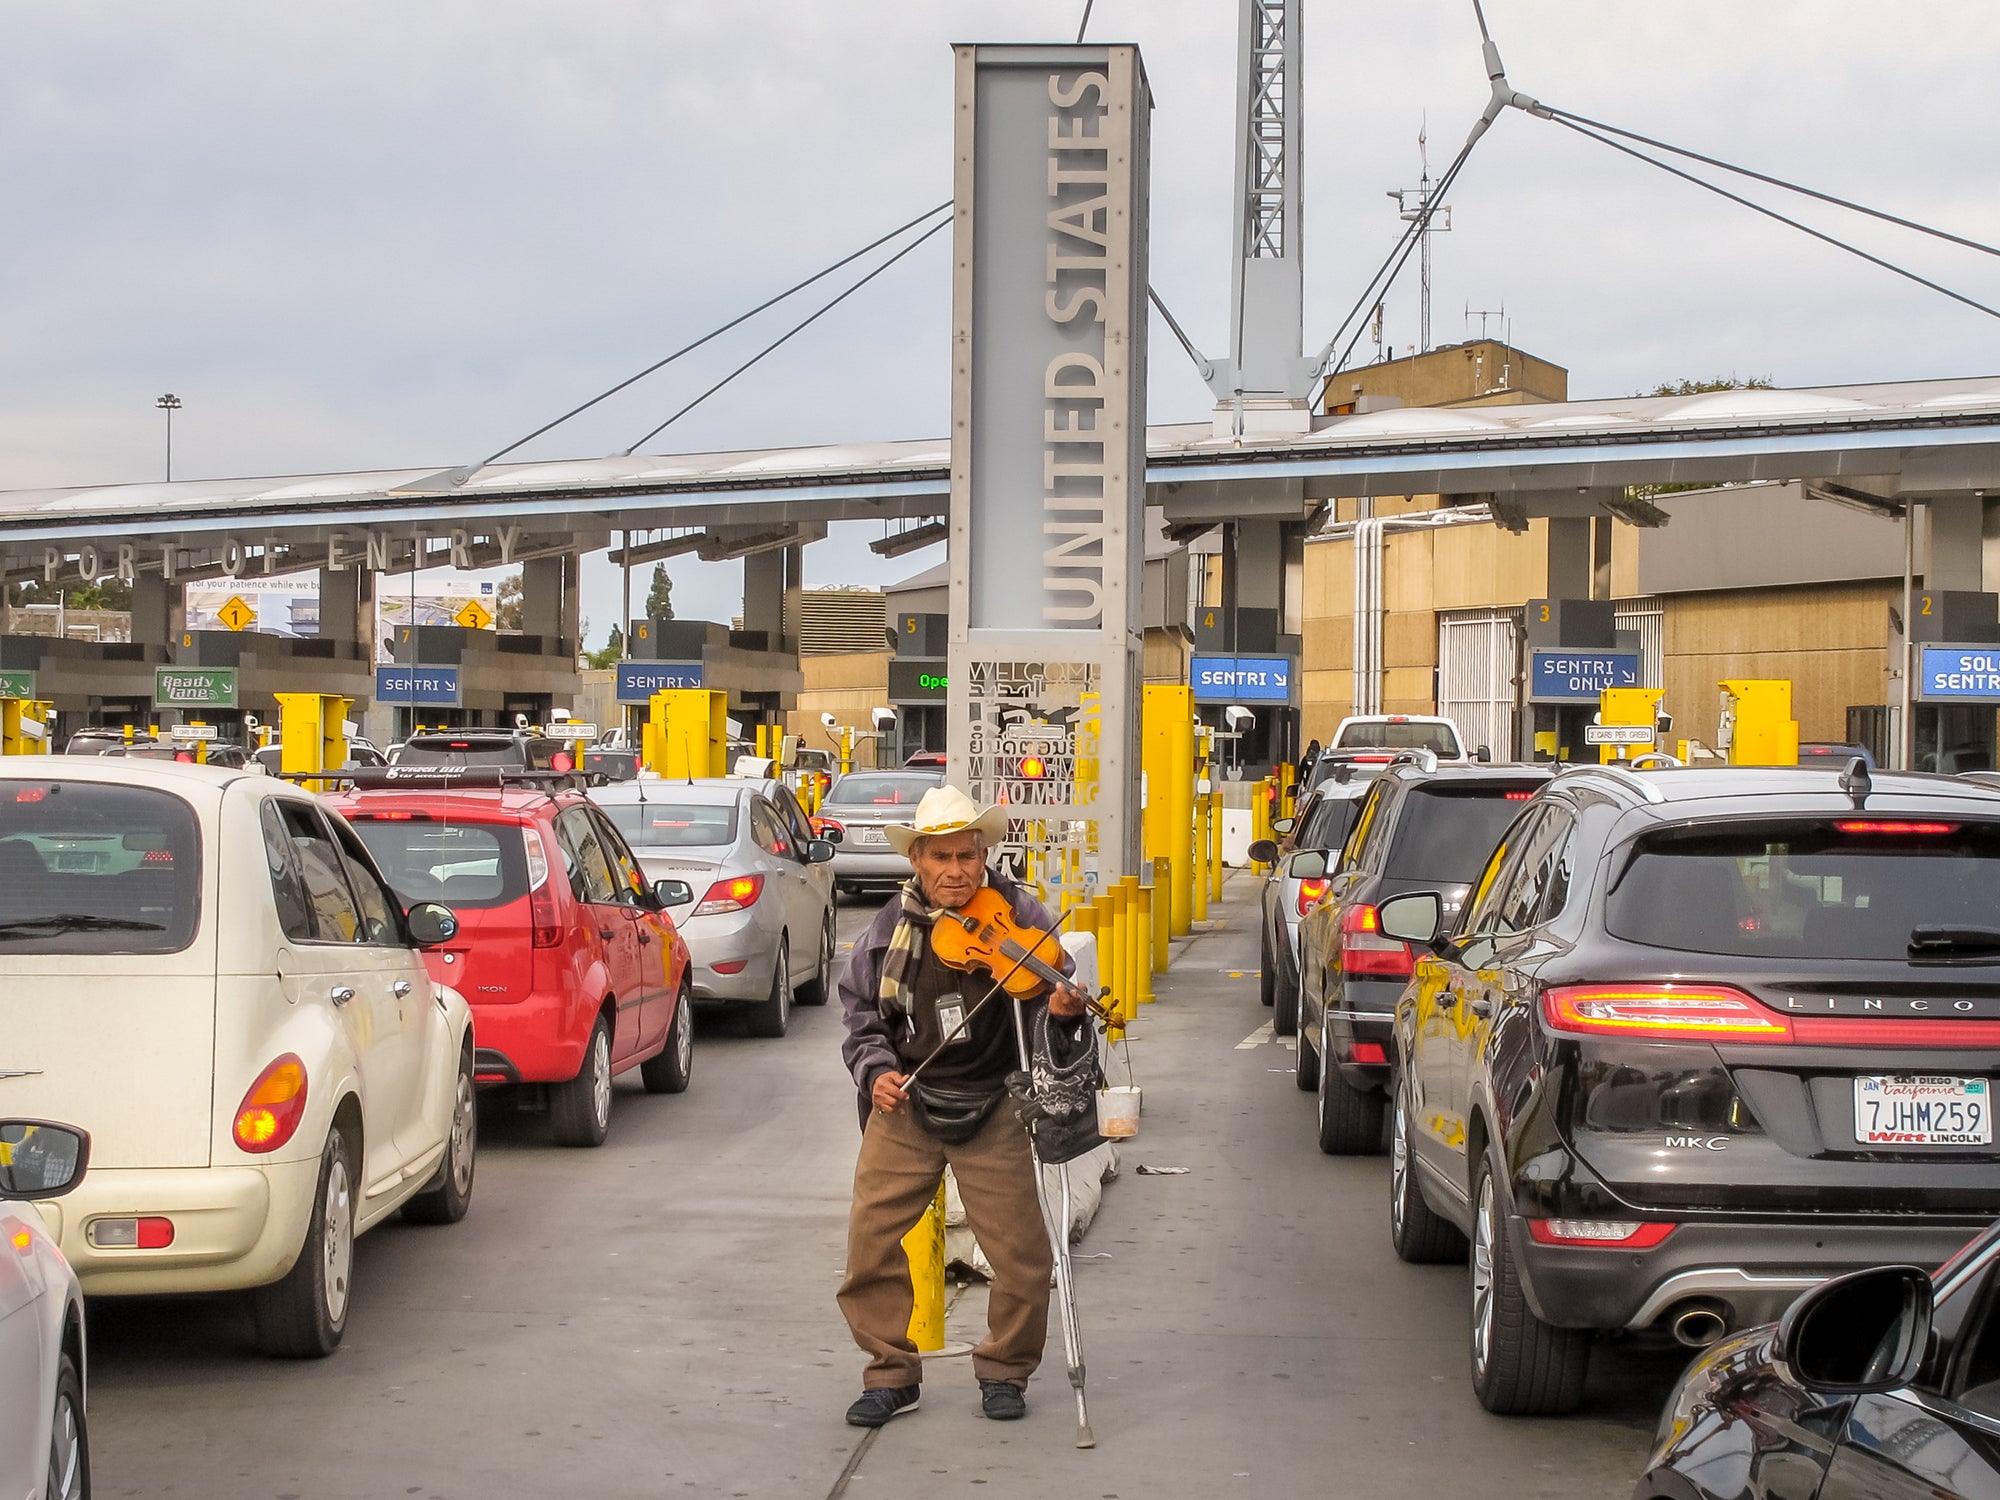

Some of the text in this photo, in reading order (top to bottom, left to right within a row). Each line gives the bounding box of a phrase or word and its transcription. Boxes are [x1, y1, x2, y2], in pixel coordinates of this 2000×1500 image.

[1046, 70, 1110, 325] STATES
[1042, 351, 1106, 622] UNITED
[44, 542, 183, 582] PORT
[221, 536, 285, 576] OF
[328, 526, 521, 572] ENTRY
[206, 580, 226, 589] your
[229, 579, 267, 589] patience
[270, 580, 294, 590] while
[1539, 604, 1551, 622] 3
[1921, 597, 1933, 615] 2
[231, 610, 240, 625] 1
[1203, 612, 1215, 629] 4
[638, 624, 649, 639] 6
[906, 617, 917, 634] 5
[183, 633, 192, 648] 8
[402, 629, 411, 644] 7
[1543, 660, 1614, 675] SENTRI
[1959, 656, 2000, 672] SOL
[163, 675, 215, 692] Ready
[385, 679, 439, 691] SENTRI
[626, 676, 683, 688] SENTRI
[1200, 671, 1267, 686] SENTRI
[1569, 677, 1613, 691] ONLY
[169, 686, 210, 700] Lane
[1597, 731, 1613, 739] CARS
[1615, 731, 1626, 739] PER
[1630, 731, 1649, 739] GREEN
[478, 985, 508, 993] IKON
[1863, 1082, 1880, 1091] JAN
[1894, 1077, 1952, 1085] SAN DIEGO
[1883, 1084, 1964, 1100] California
[1866, 1101, 1981, 1132] 7JHM259
[1665, 1136, 1731, 1151] MKC
[1868, 1132, 1982, 1143] Witt LINCOLN
